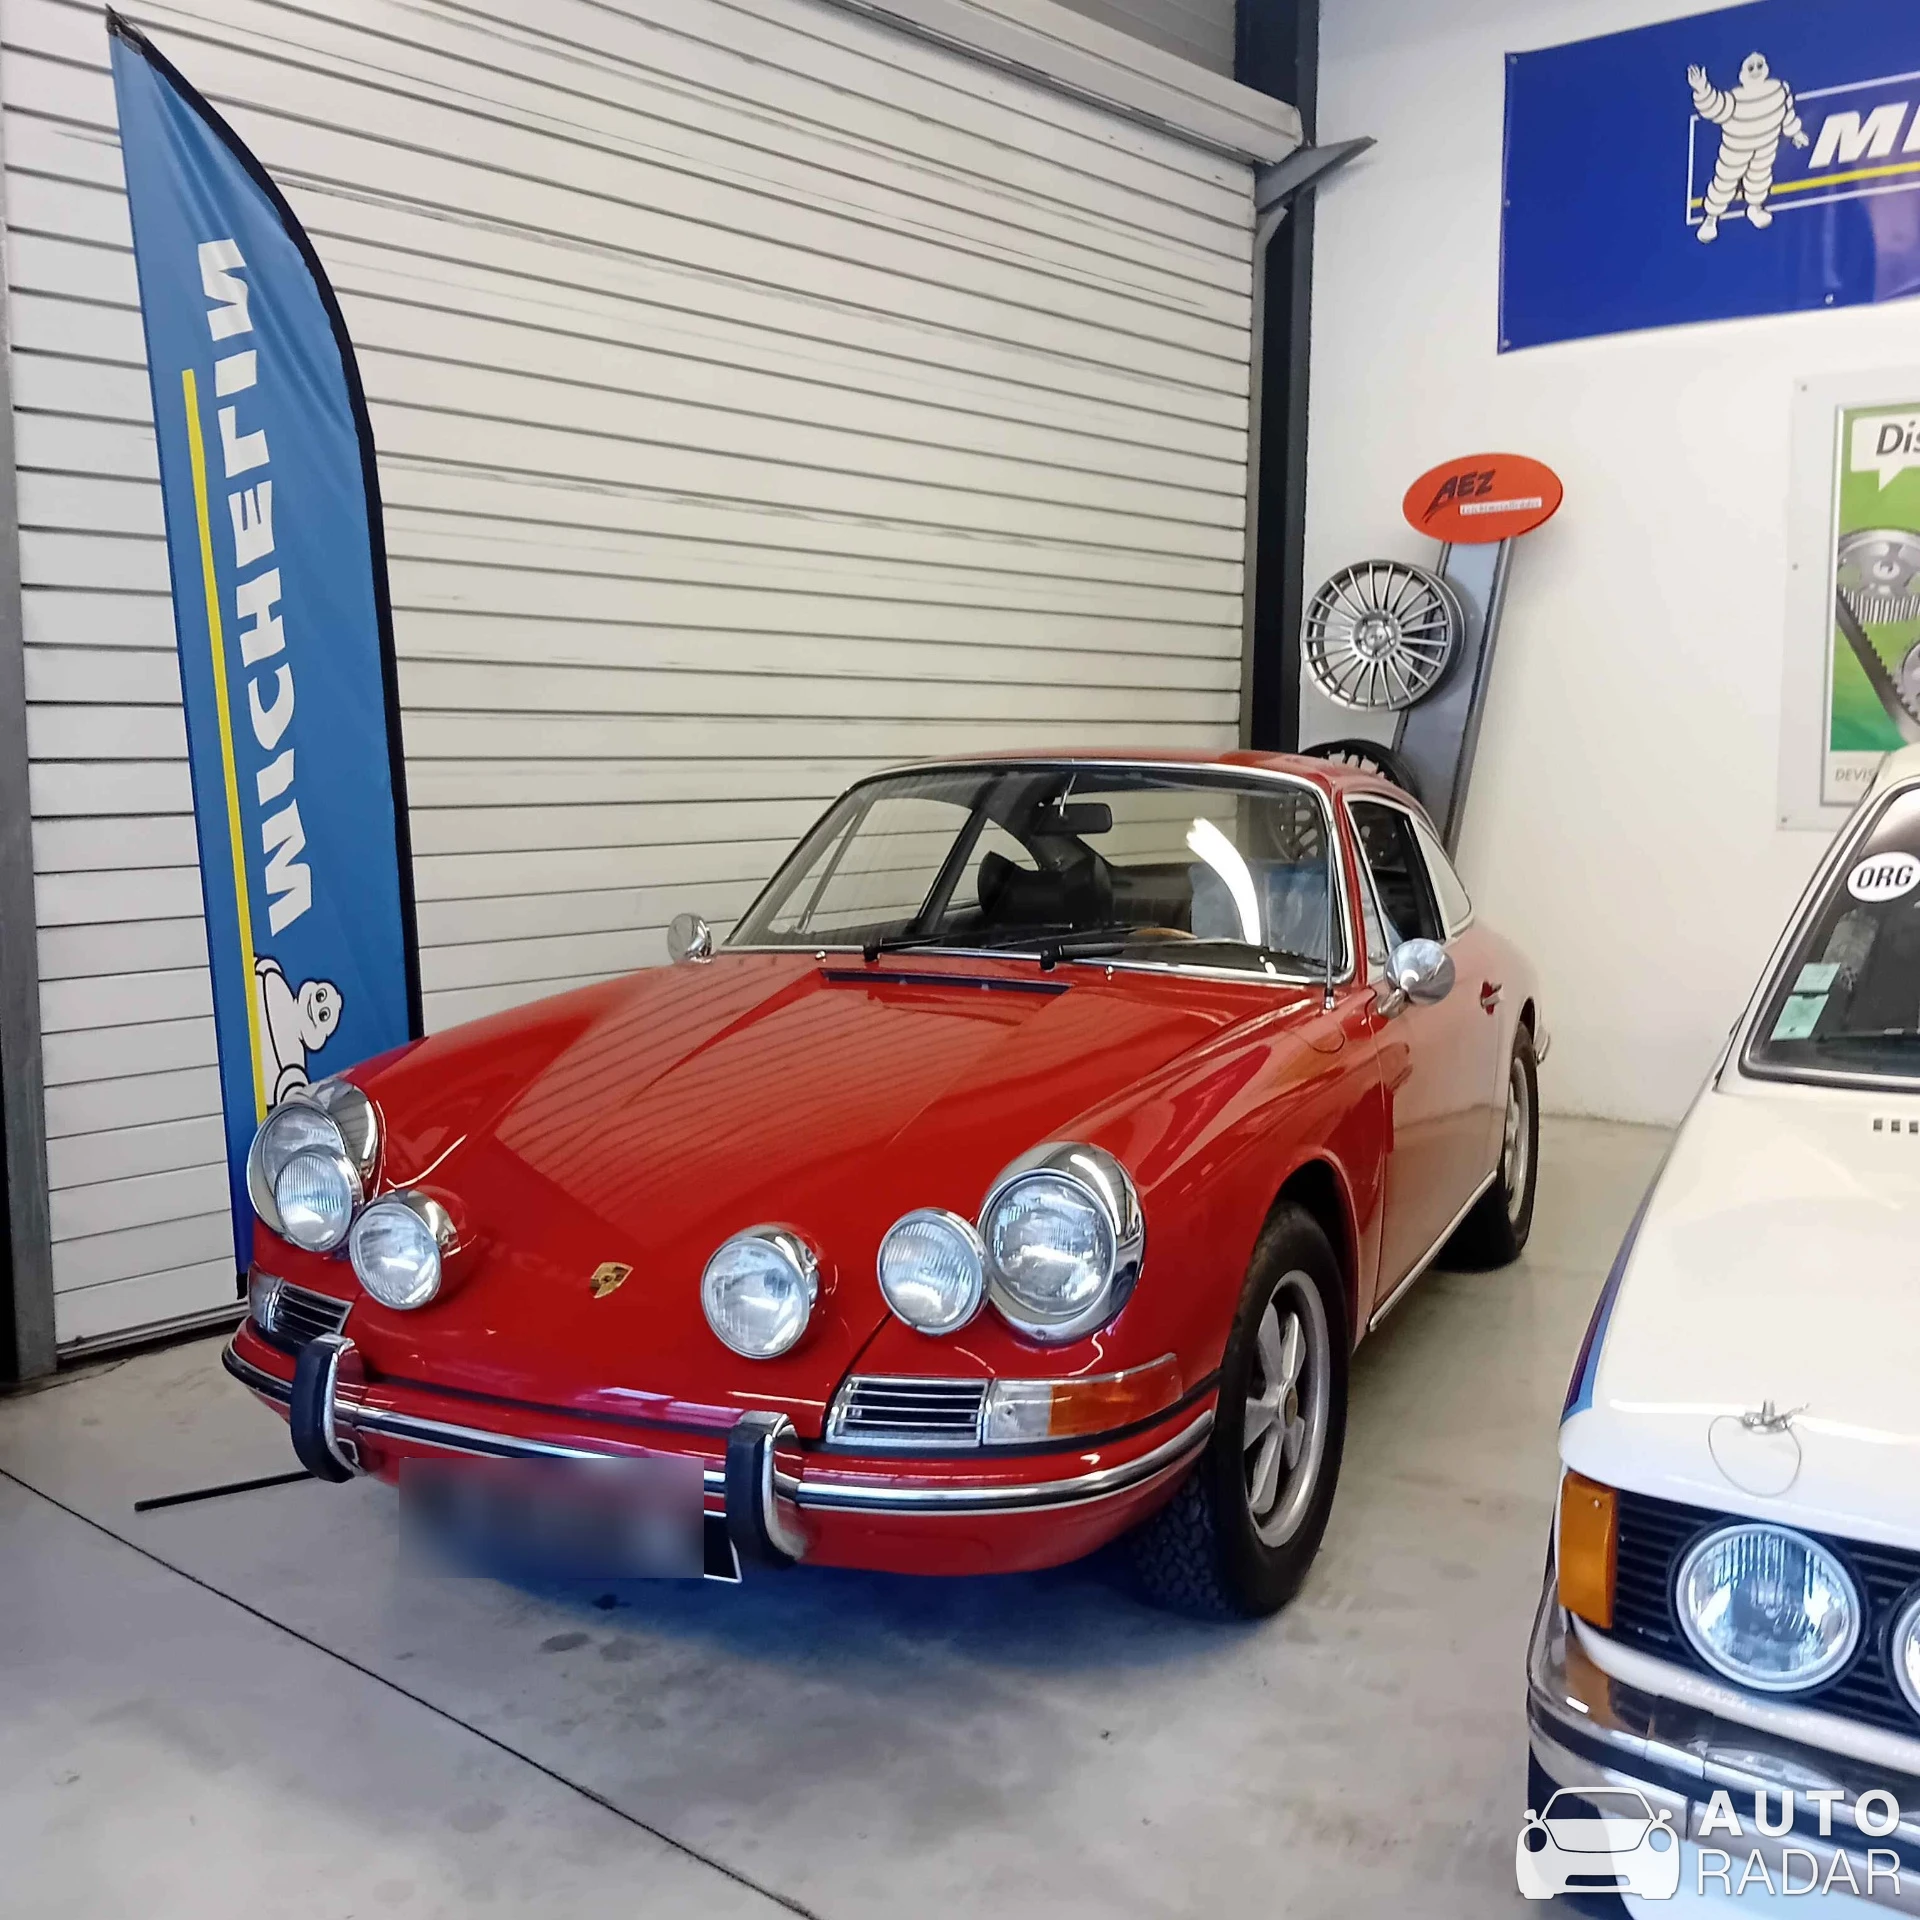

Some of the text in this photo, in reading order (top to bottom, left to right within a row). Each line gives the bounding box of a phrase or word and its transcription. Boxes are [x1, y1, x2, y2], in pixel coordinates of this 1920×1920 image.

[1422, 469, 1496, 524] AEZ
[198, 238, 312, 937] MICHELIN
[1857, 865, 1914, 889] ORG
